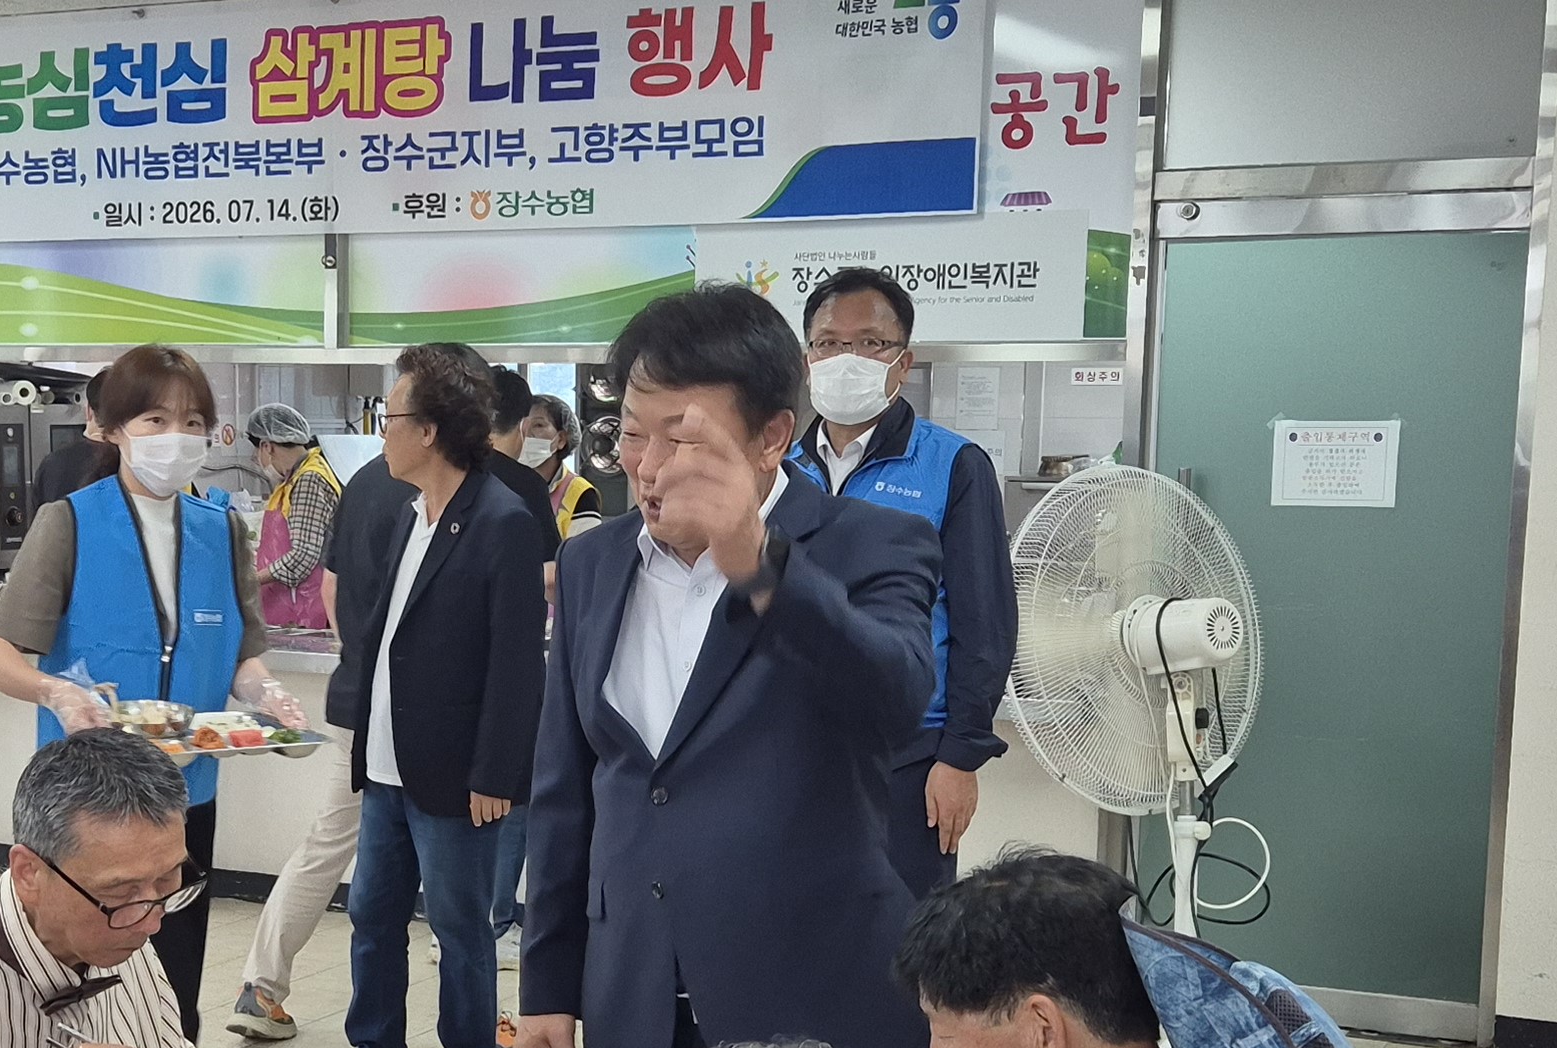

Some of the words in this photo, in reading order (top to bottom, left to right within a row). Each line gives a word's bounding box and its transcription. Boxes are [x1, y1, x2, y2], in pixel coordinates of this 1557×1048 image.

[835, 19, 886, 38] 대한민국
[891, 15, 919, 35] 농협
[251, 17, 451, 123] 삼계탕
[469, 15, 600, 104] 나눔
[626, 1, 773, 97] 행사
[991, 66, 1120, 149] 공간
[96, 137, 326, 181] NH농협전북본부
[360, 128, 536, 172] 장수군지부,
[547, 115, 764, 164] 고향주부모임
[496, 187, 595, 218] 장수농협
[1074, 371, 1120, 382] 화상주의
